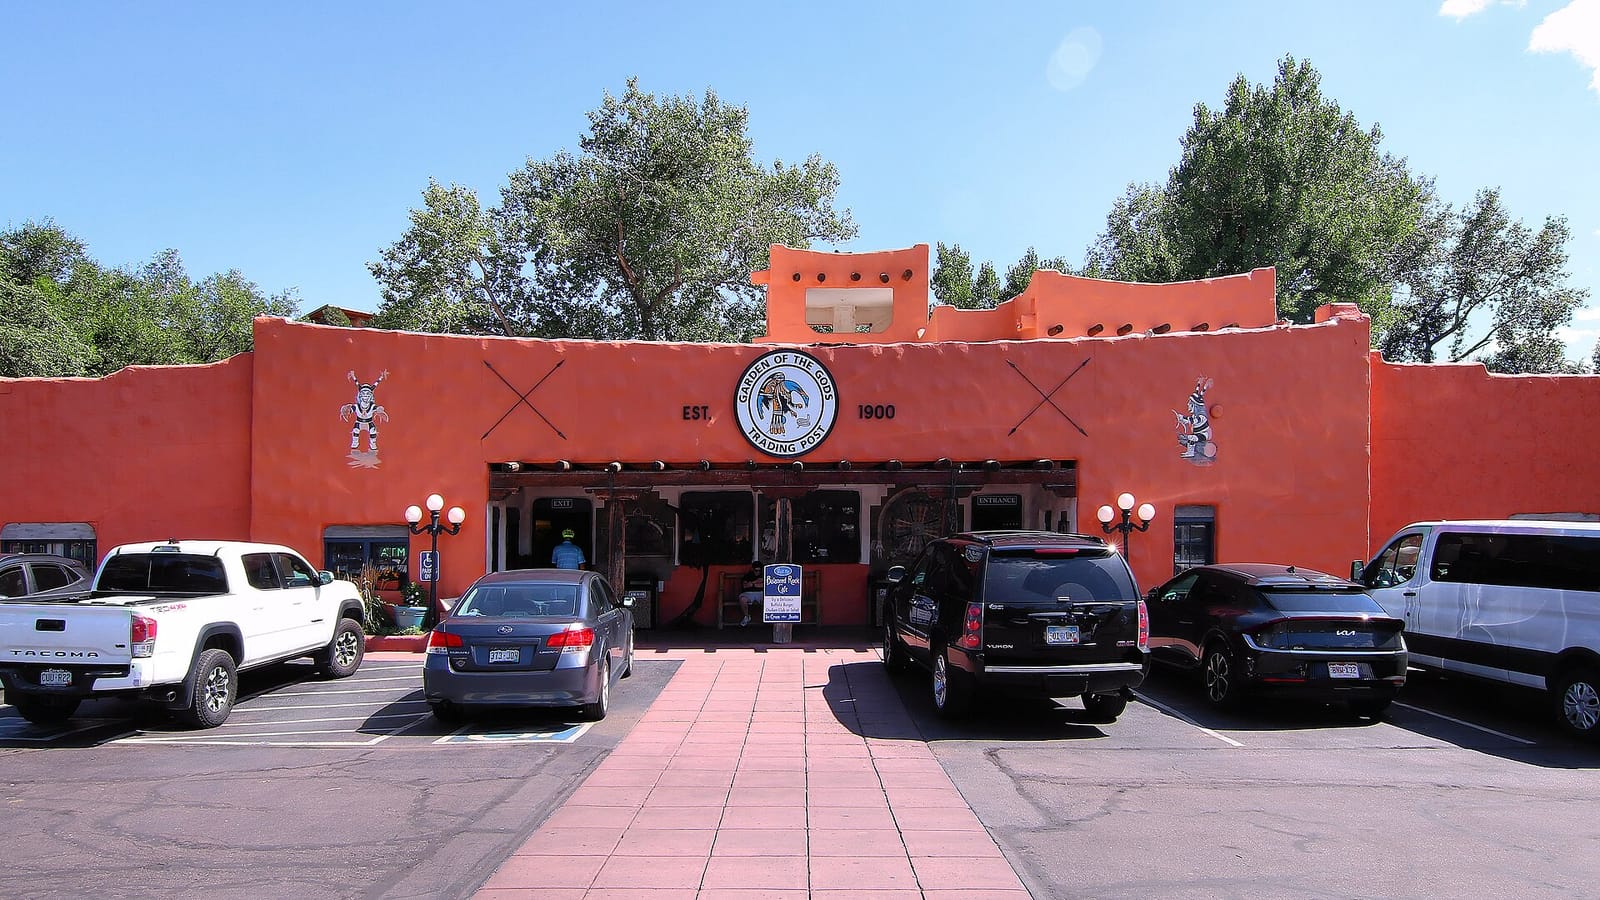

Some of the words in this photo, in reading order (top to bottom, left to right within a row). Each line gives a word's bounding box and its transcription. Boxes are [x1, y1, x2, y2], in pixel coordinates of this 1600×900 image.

[738, 359, 771, 404] GARDEN
[773, 354, 789, 365] OF
[793, 355, 814, 370] THE
[815, 370, 834, 401] GODS
[682, 405, 712, 421] EST.
[858, 404, 896, 419] 1900
[747, 426, 796, 453] TRADING
[800, 425, 826, 449] POST
[553, 499, 570, 507] EXIT
[380, 547, 406, 557] ATM
[787, 575, 800, 586] Rock
